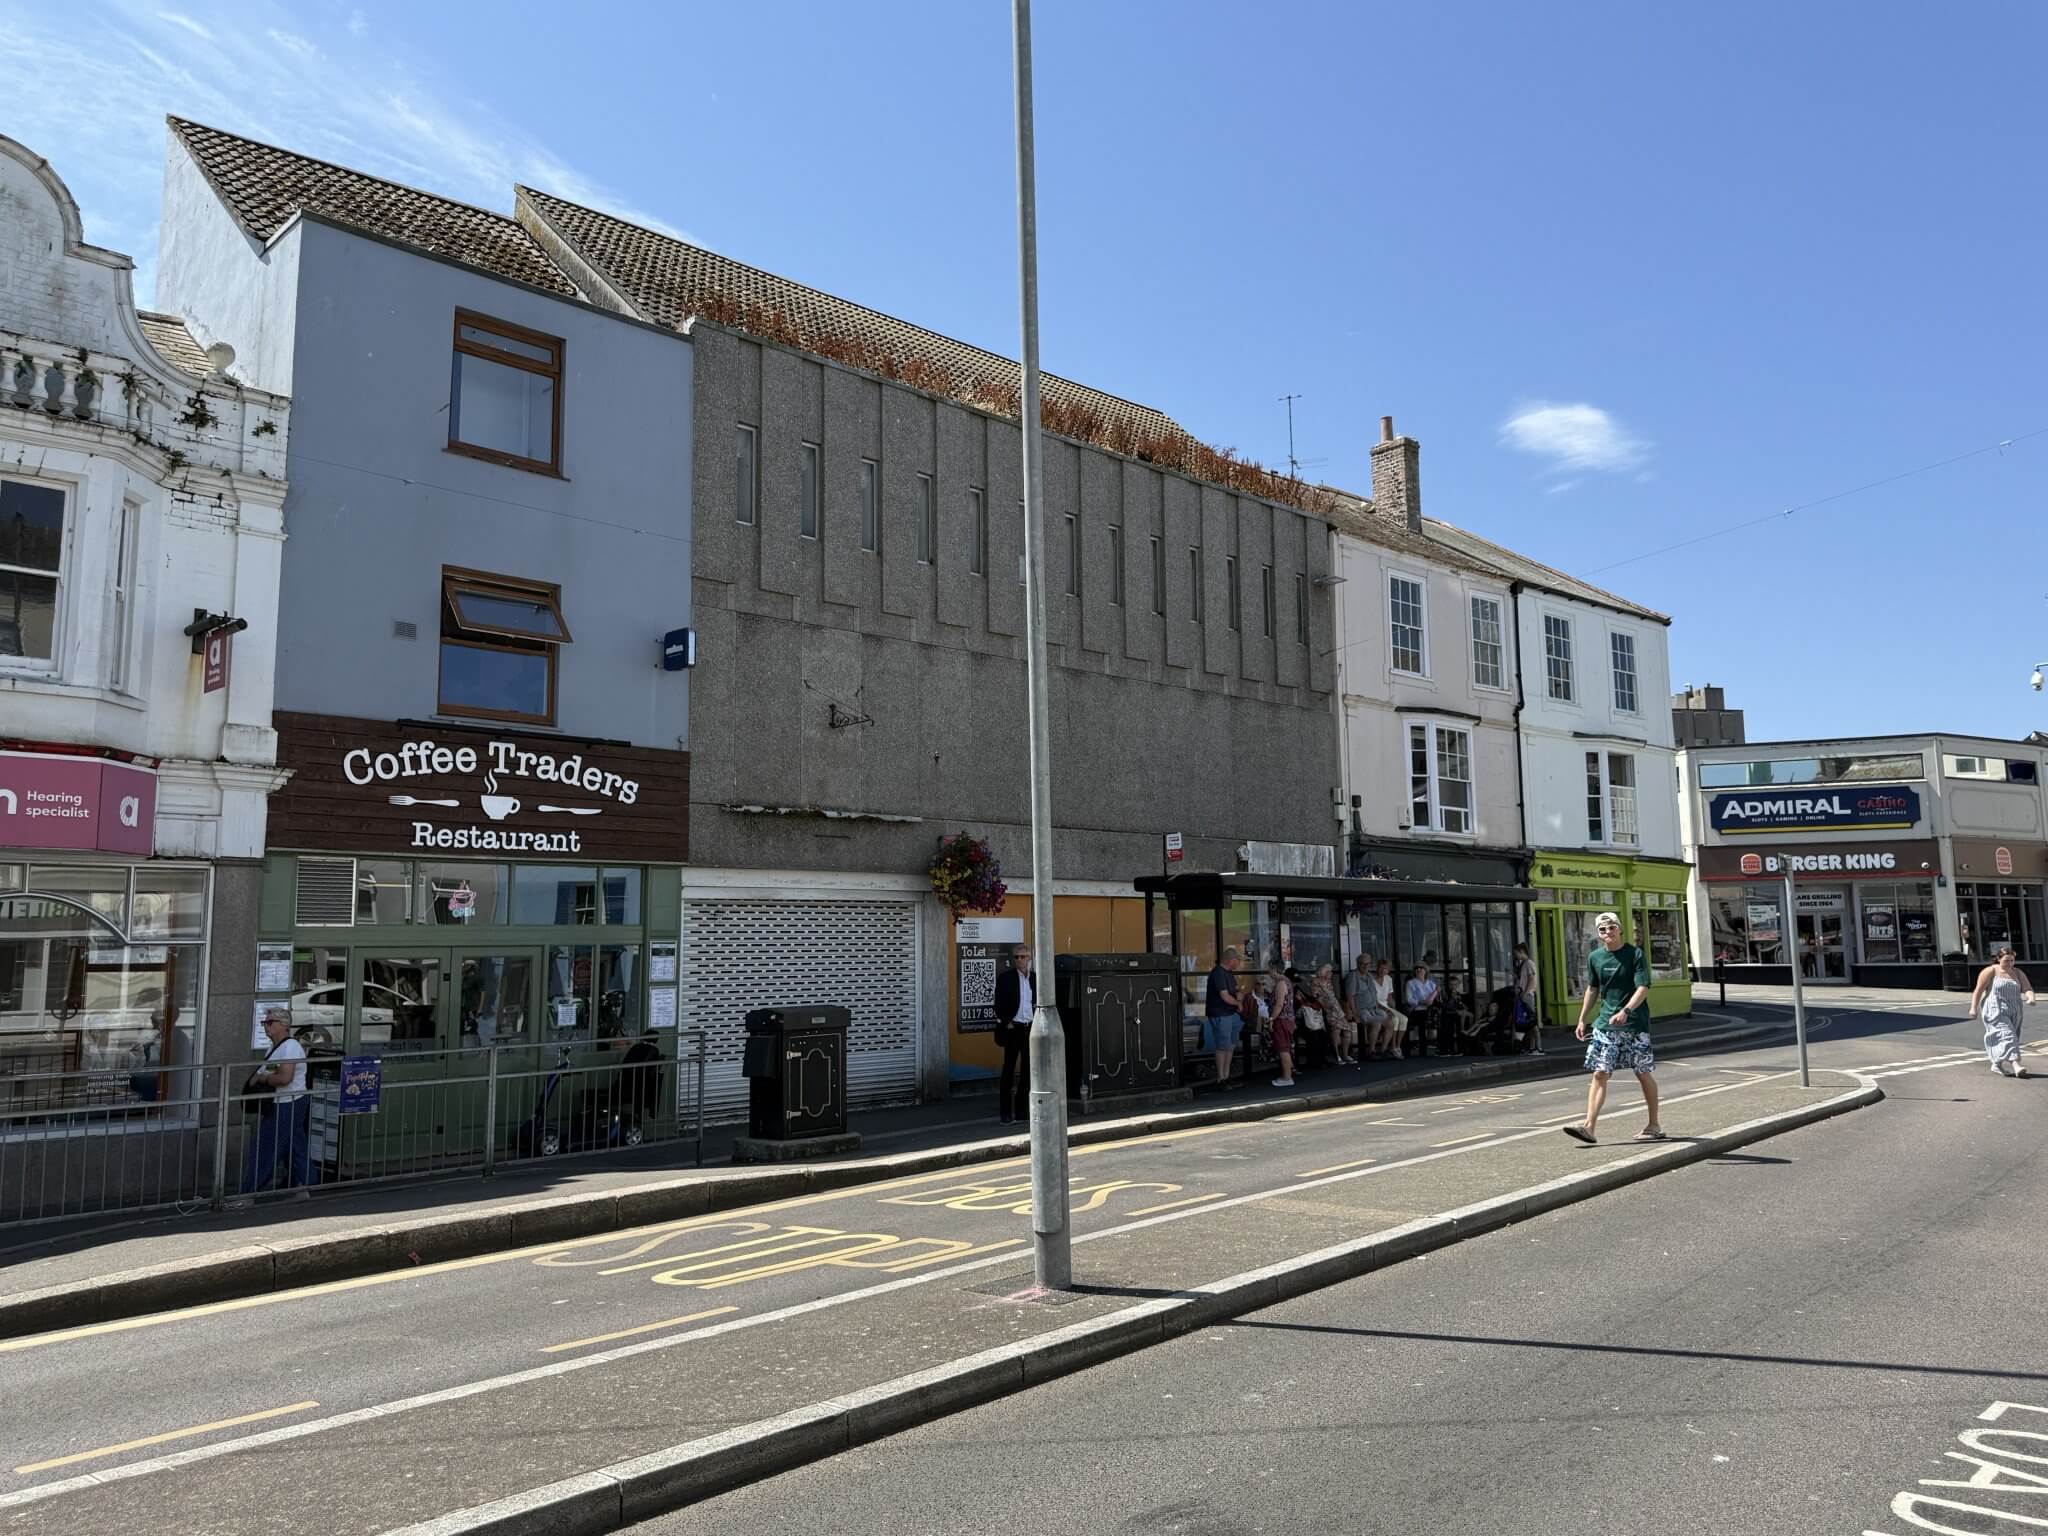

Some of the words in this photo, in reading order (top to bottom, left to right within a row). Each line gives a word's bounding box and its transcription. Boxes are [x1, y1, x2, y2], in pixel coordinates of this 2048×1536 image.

[343, 741, 477, 785] Coffee
[488, 741, 640, 804] Traders
[26, 790, 83, 806] Hearing
[1857, 798, 1906, 809] CASINO
[25, 806, 90, 819] specialist
[1721, 796, 1852, 820] ADMIRAL
[410, 821, 582, 853] Restaurant
[1765, 854, 1843, 872] BRGER
[1845, 853, 1896, 870] KING
[961, 945, 973, 957] To
[973, 945, 987, 957] Let
[961, 1008, 982, 1019] 0117
[531, 1222, 974, 1290] STOP
